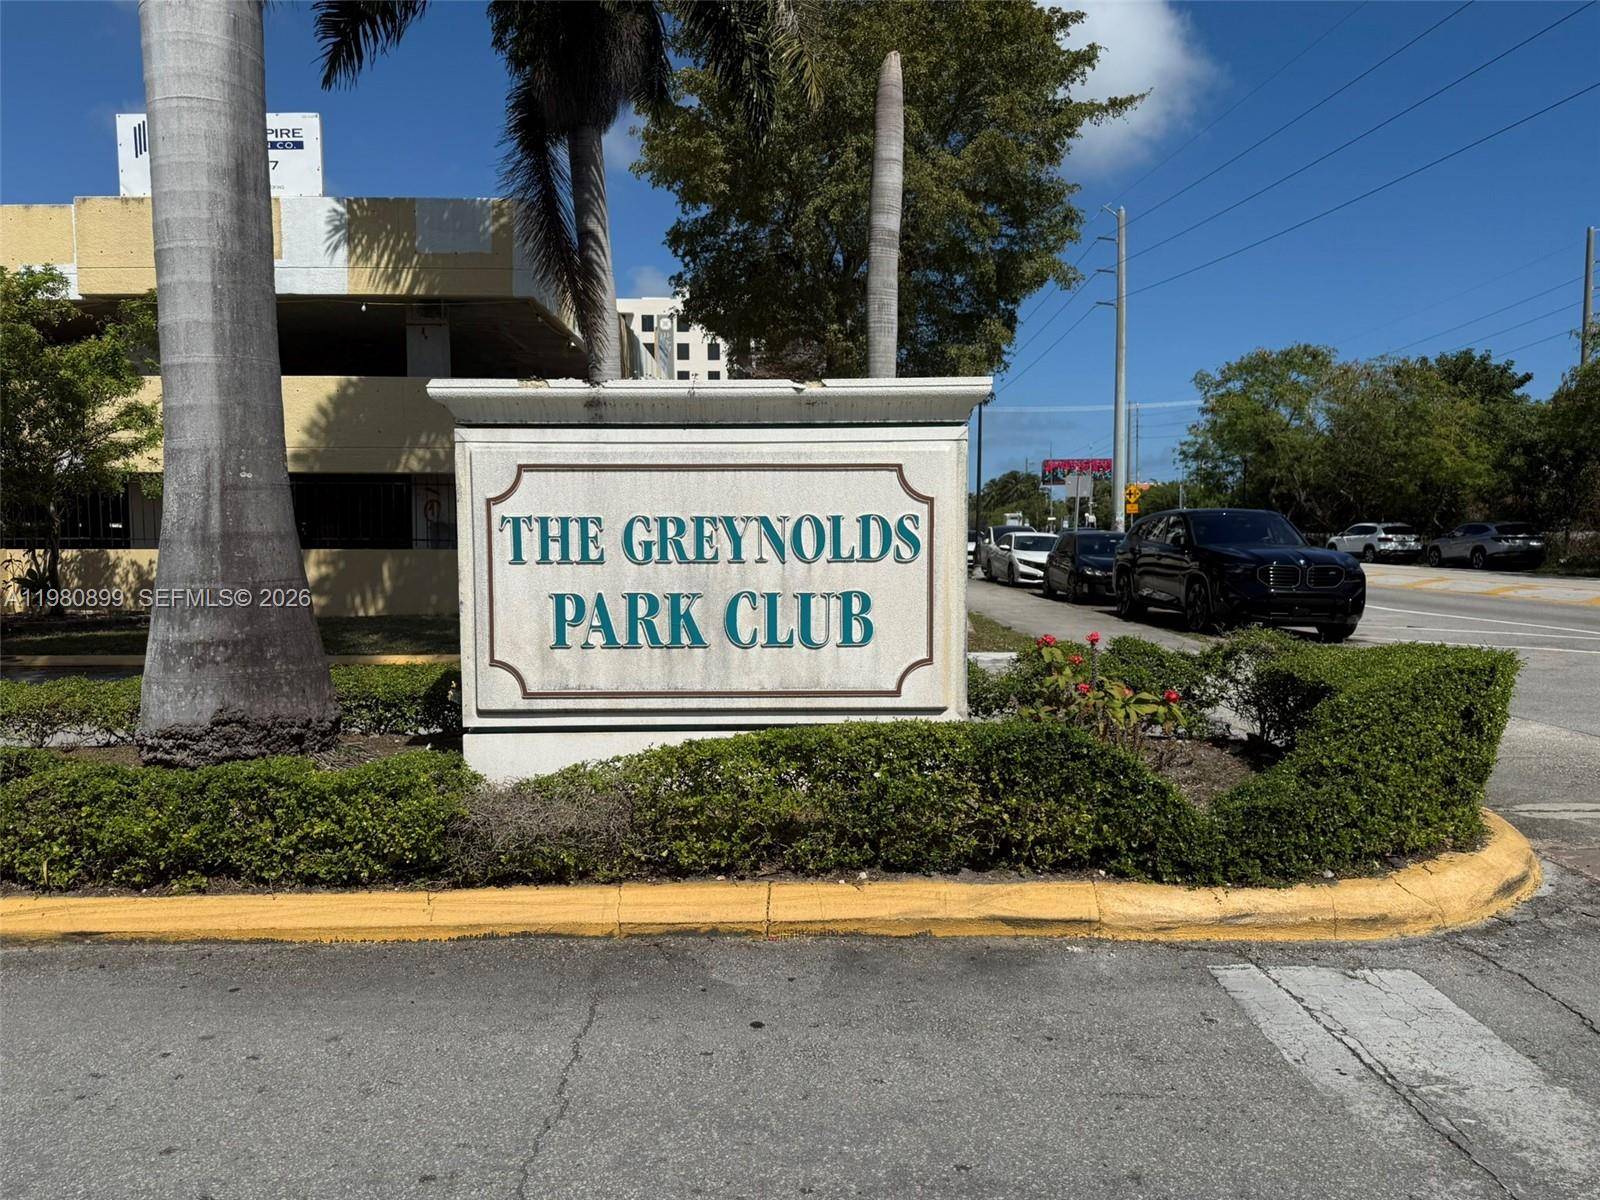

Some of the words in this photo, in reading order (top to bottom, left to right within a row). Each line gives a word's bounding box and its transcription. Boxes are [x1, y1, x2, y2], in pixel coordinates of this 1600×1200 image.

[499, 515, 605, 564] THE
[621, 513, 921, 564] GREYNOLDS
[548, 590, 710, 649] PARK
[724, 590, 874, 650] CLUB
